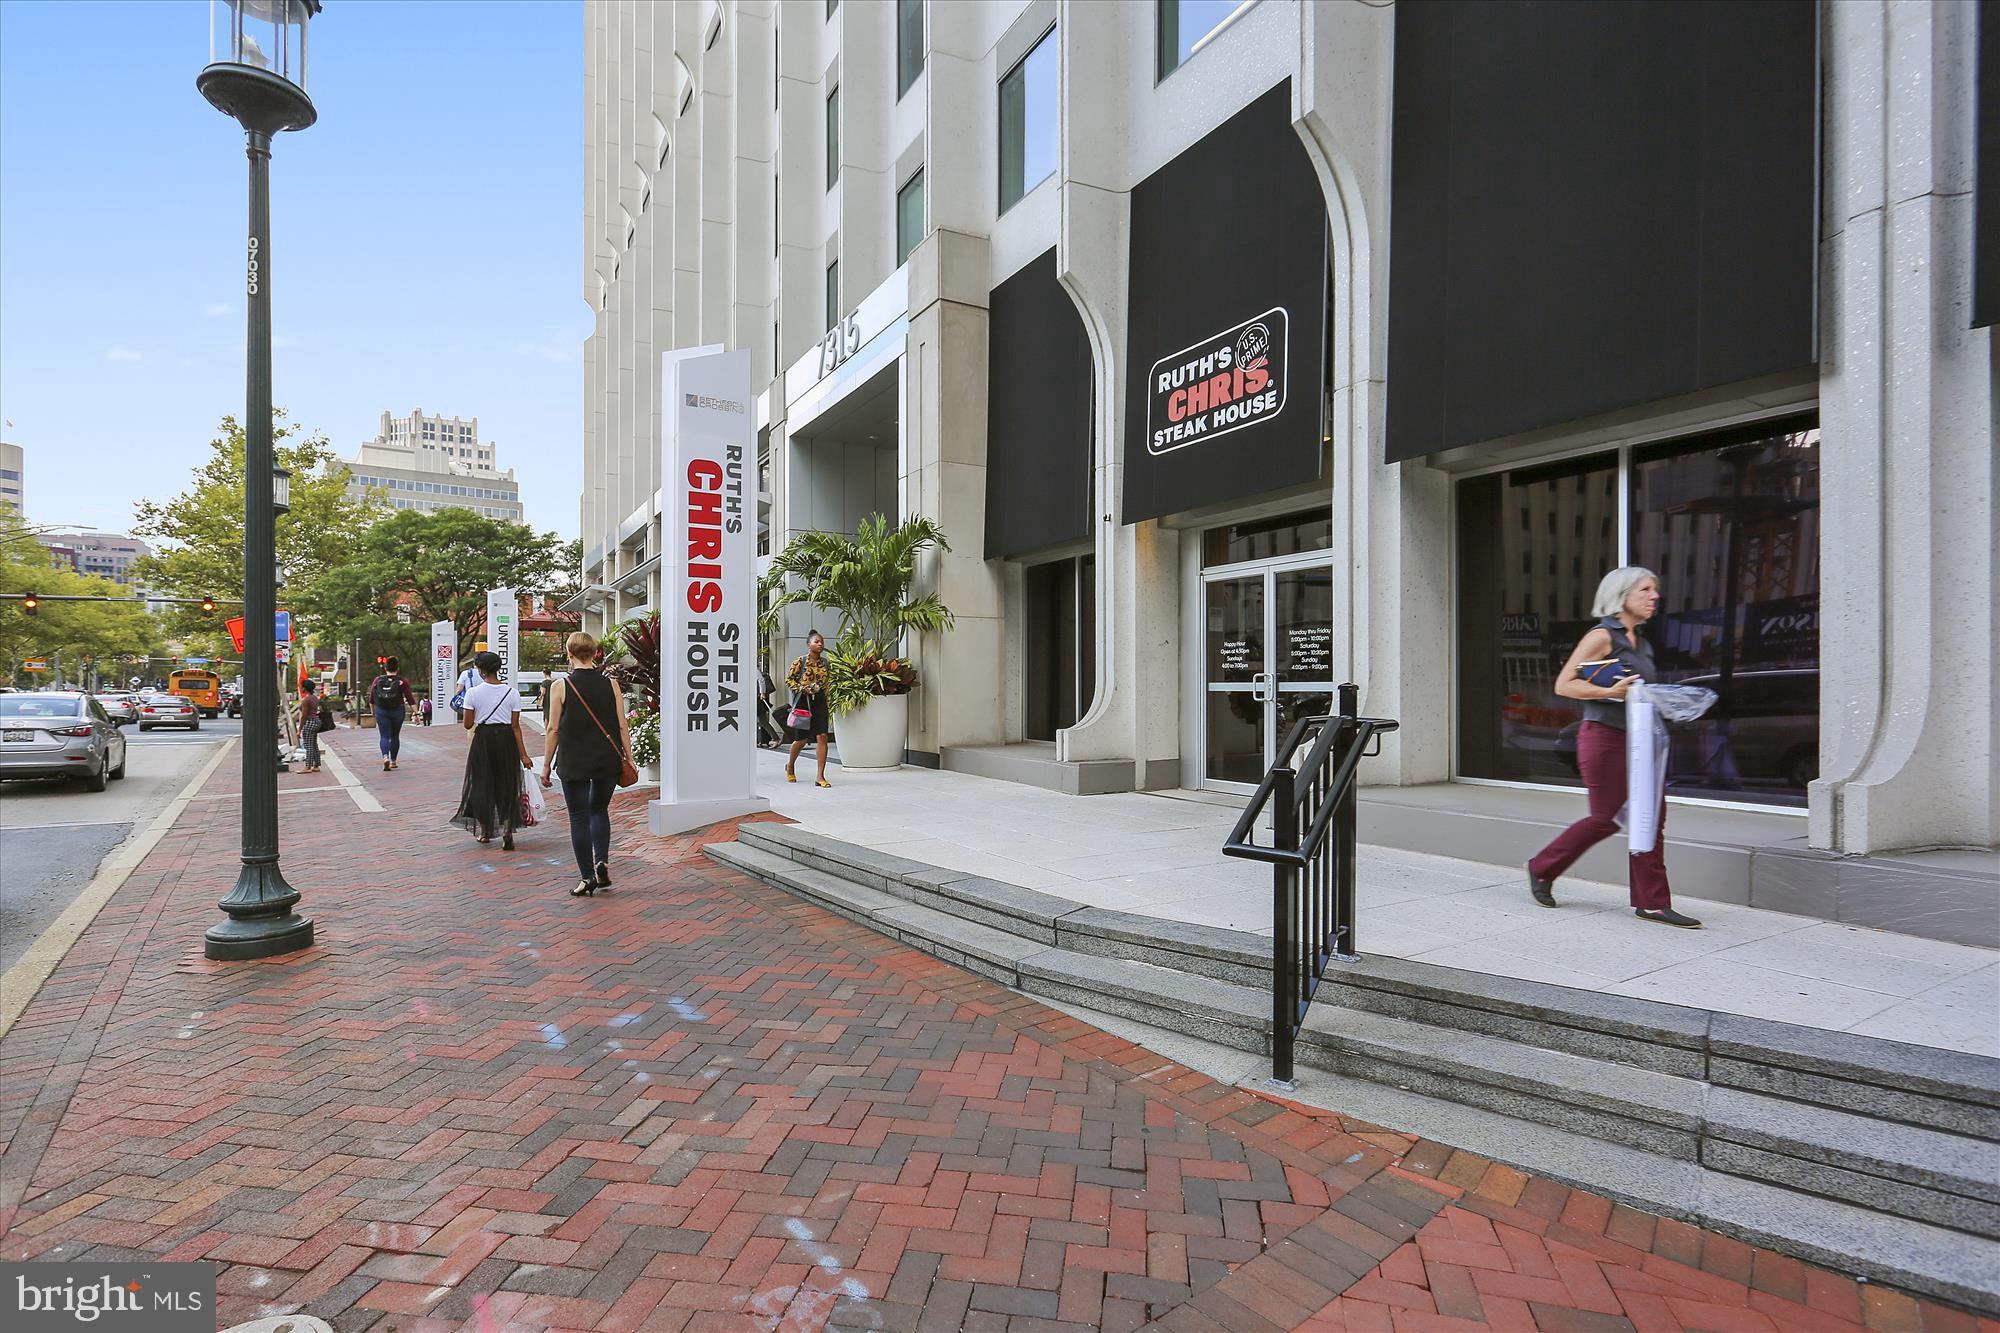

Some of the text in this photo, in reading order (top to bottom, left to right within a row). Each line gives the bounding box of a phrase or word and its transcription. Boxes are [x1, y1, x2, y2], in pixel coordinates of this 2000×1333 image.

[248, 237, 259, 295] 07030
[816, 308, 860, 380] 7315
[1158, 346, 1232, 393] RUTH'S
[1240, 337, 1266, 368] PRIME
[1242, 332, 1258, 350] U.S.
[1168, 356, 1269, 422] CHRIS
[1153, 390, 1277, 447] STEAK HOUSE
[726, 445, 743, 534] RUTH'S
[687, 459, 723, 613] CHRIS
[498, 624, 508, 666] UNITED
[437, 659, 446, 709] Garden Inn
[687, 621, 709, 732] HOUSE
[718, 622, 739, 732] STEAK
